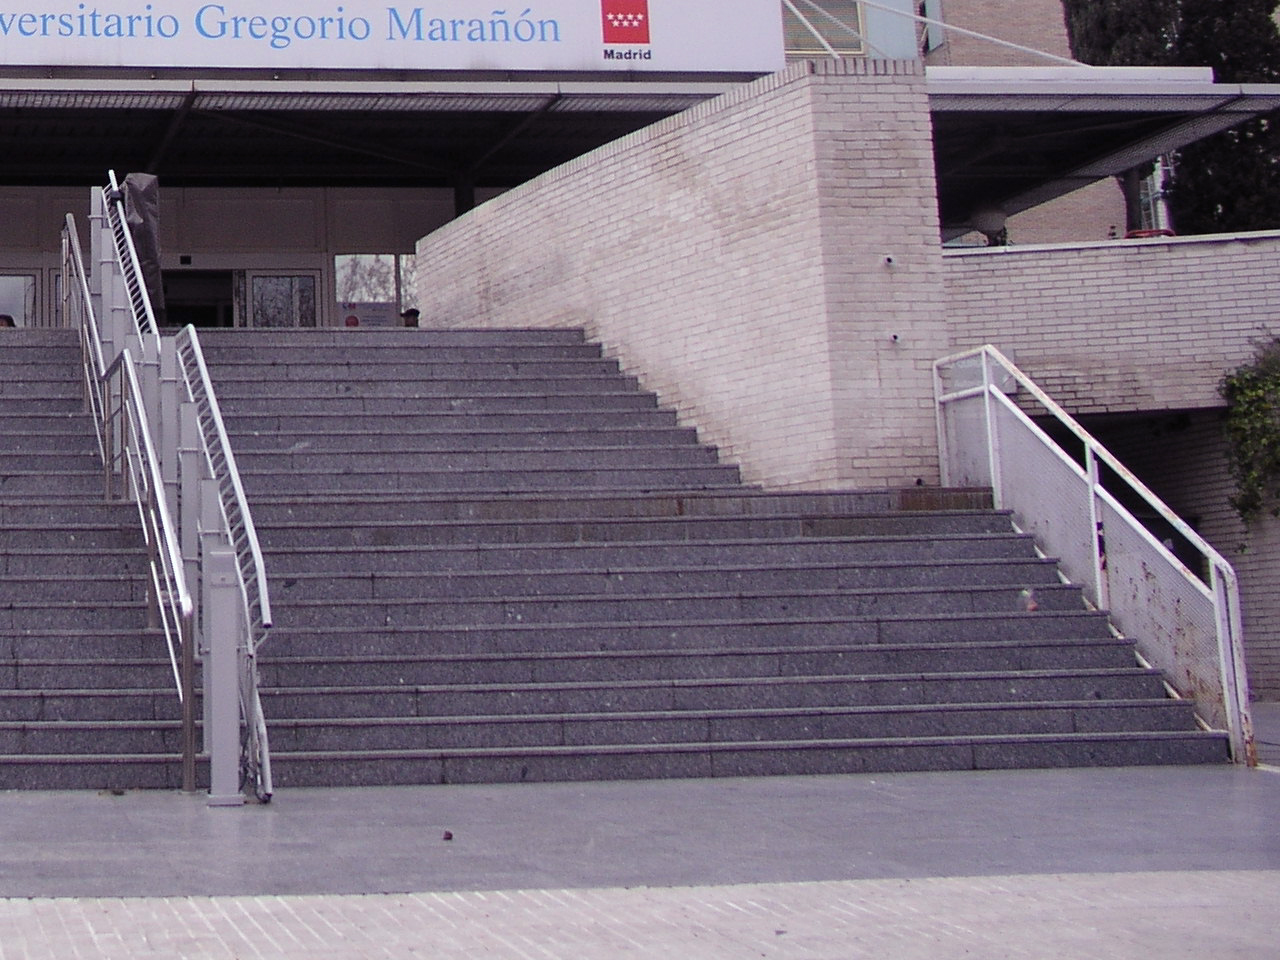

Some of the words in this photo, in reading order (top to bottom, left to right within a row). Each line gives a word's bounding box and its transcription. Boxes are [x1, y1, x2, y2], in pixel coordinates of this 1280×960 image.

[194, 4, 373, 50] Gregorio
[387, 7, 561, 43] Marañón
[603, 48, 652, 60] Madrid
